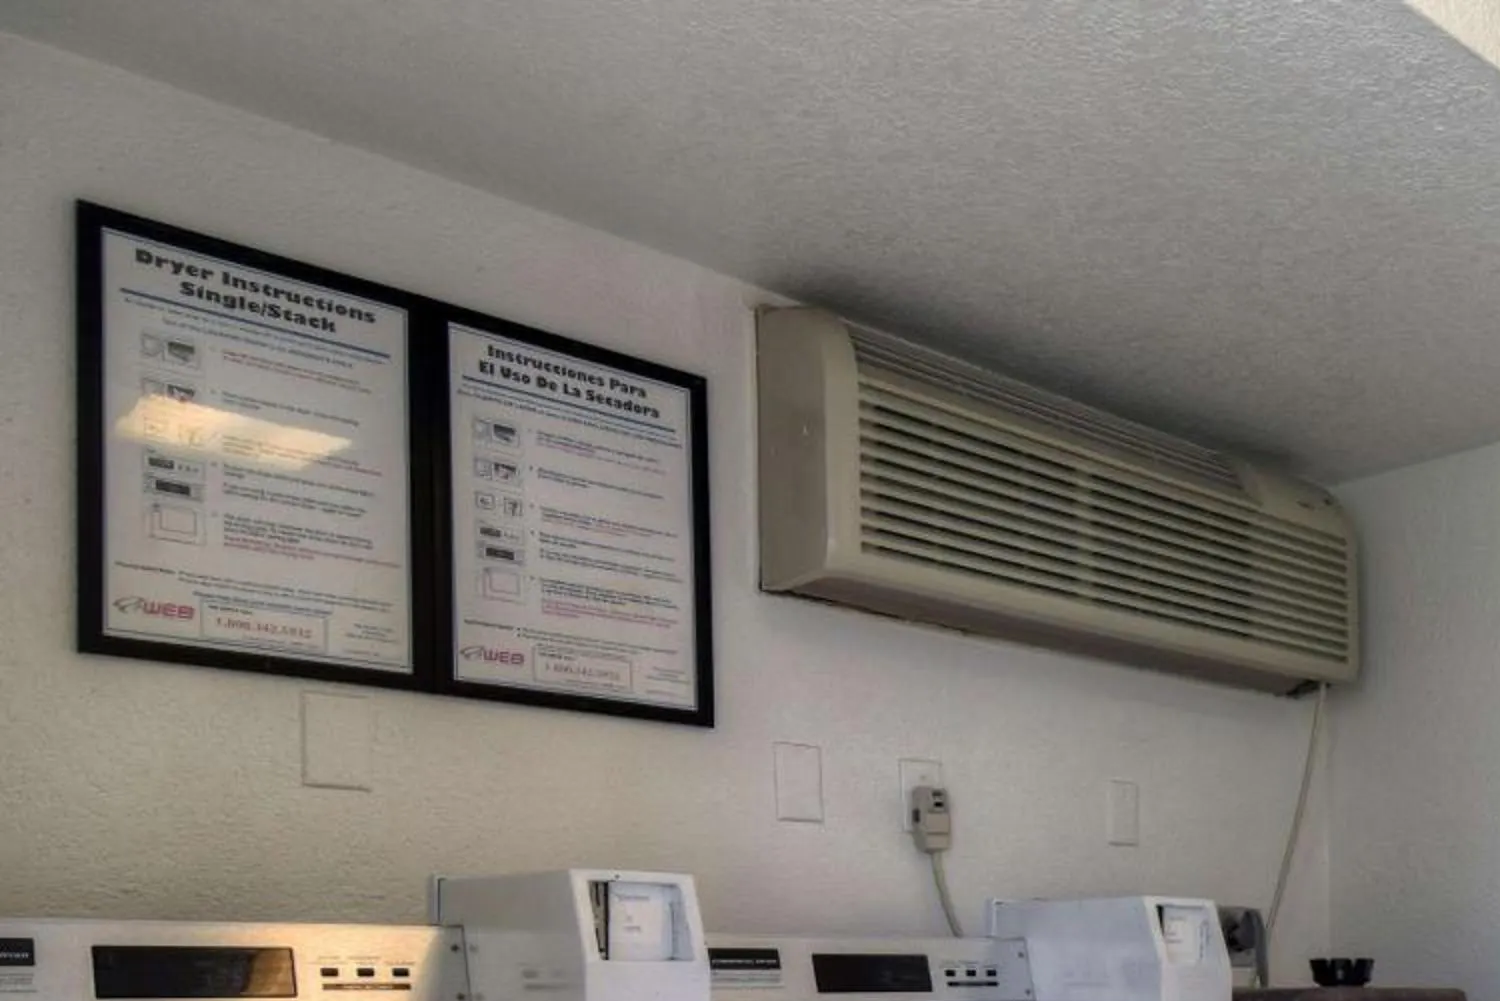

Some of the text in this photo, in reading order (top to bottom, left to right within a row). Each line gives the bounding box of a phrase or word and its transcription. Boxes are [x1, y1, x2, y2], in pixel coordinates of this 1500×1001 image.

[135, 248, 377, 324] Dryer Instructions
[179, 281, 336, 333] Single/Stack
[478, 360, 661, 419] El Uso De La Secadora
[487, 344, 648, 399] Instrucciones Para
